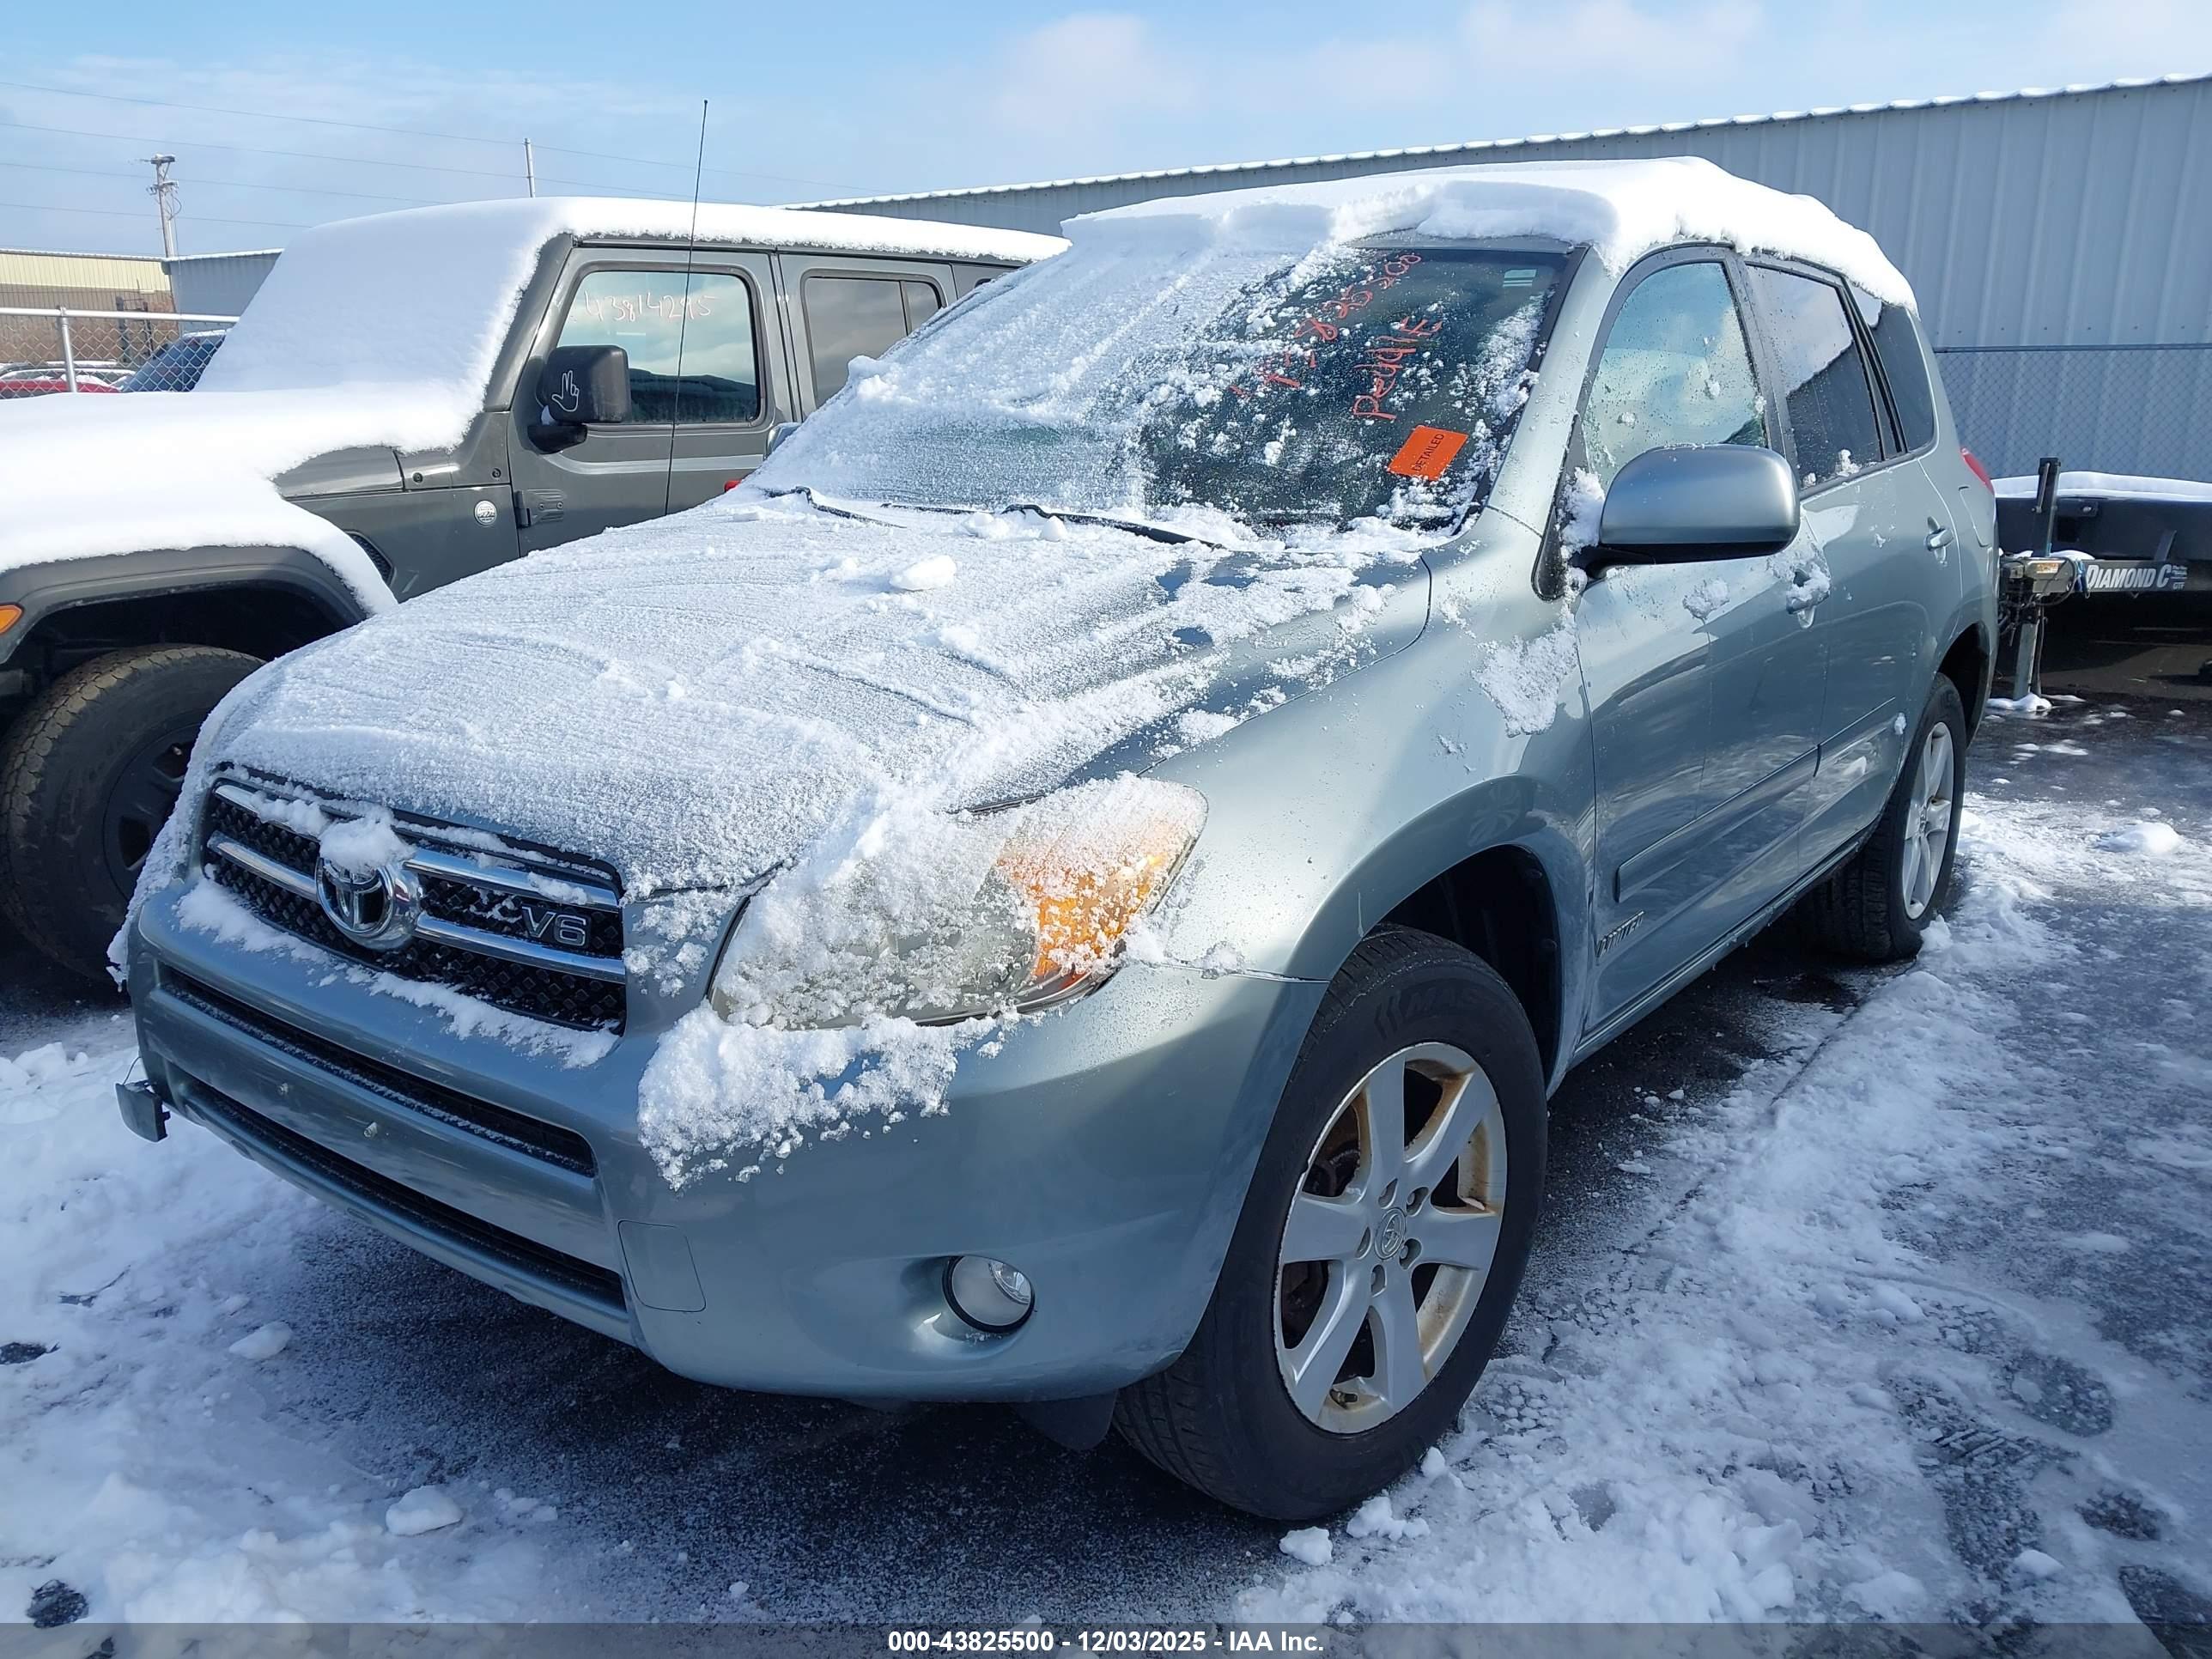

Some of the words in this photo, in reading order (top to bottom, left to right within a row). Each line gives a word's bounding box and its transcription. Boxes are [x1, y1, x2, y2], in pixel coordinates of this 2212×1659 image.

[1412, 433, 1445, 472] DETAILED
[2086, 564, 2157, 589] DIAMOND
[2156, 563, 2172, 588] C
[521, 906, 587, 946] V6
